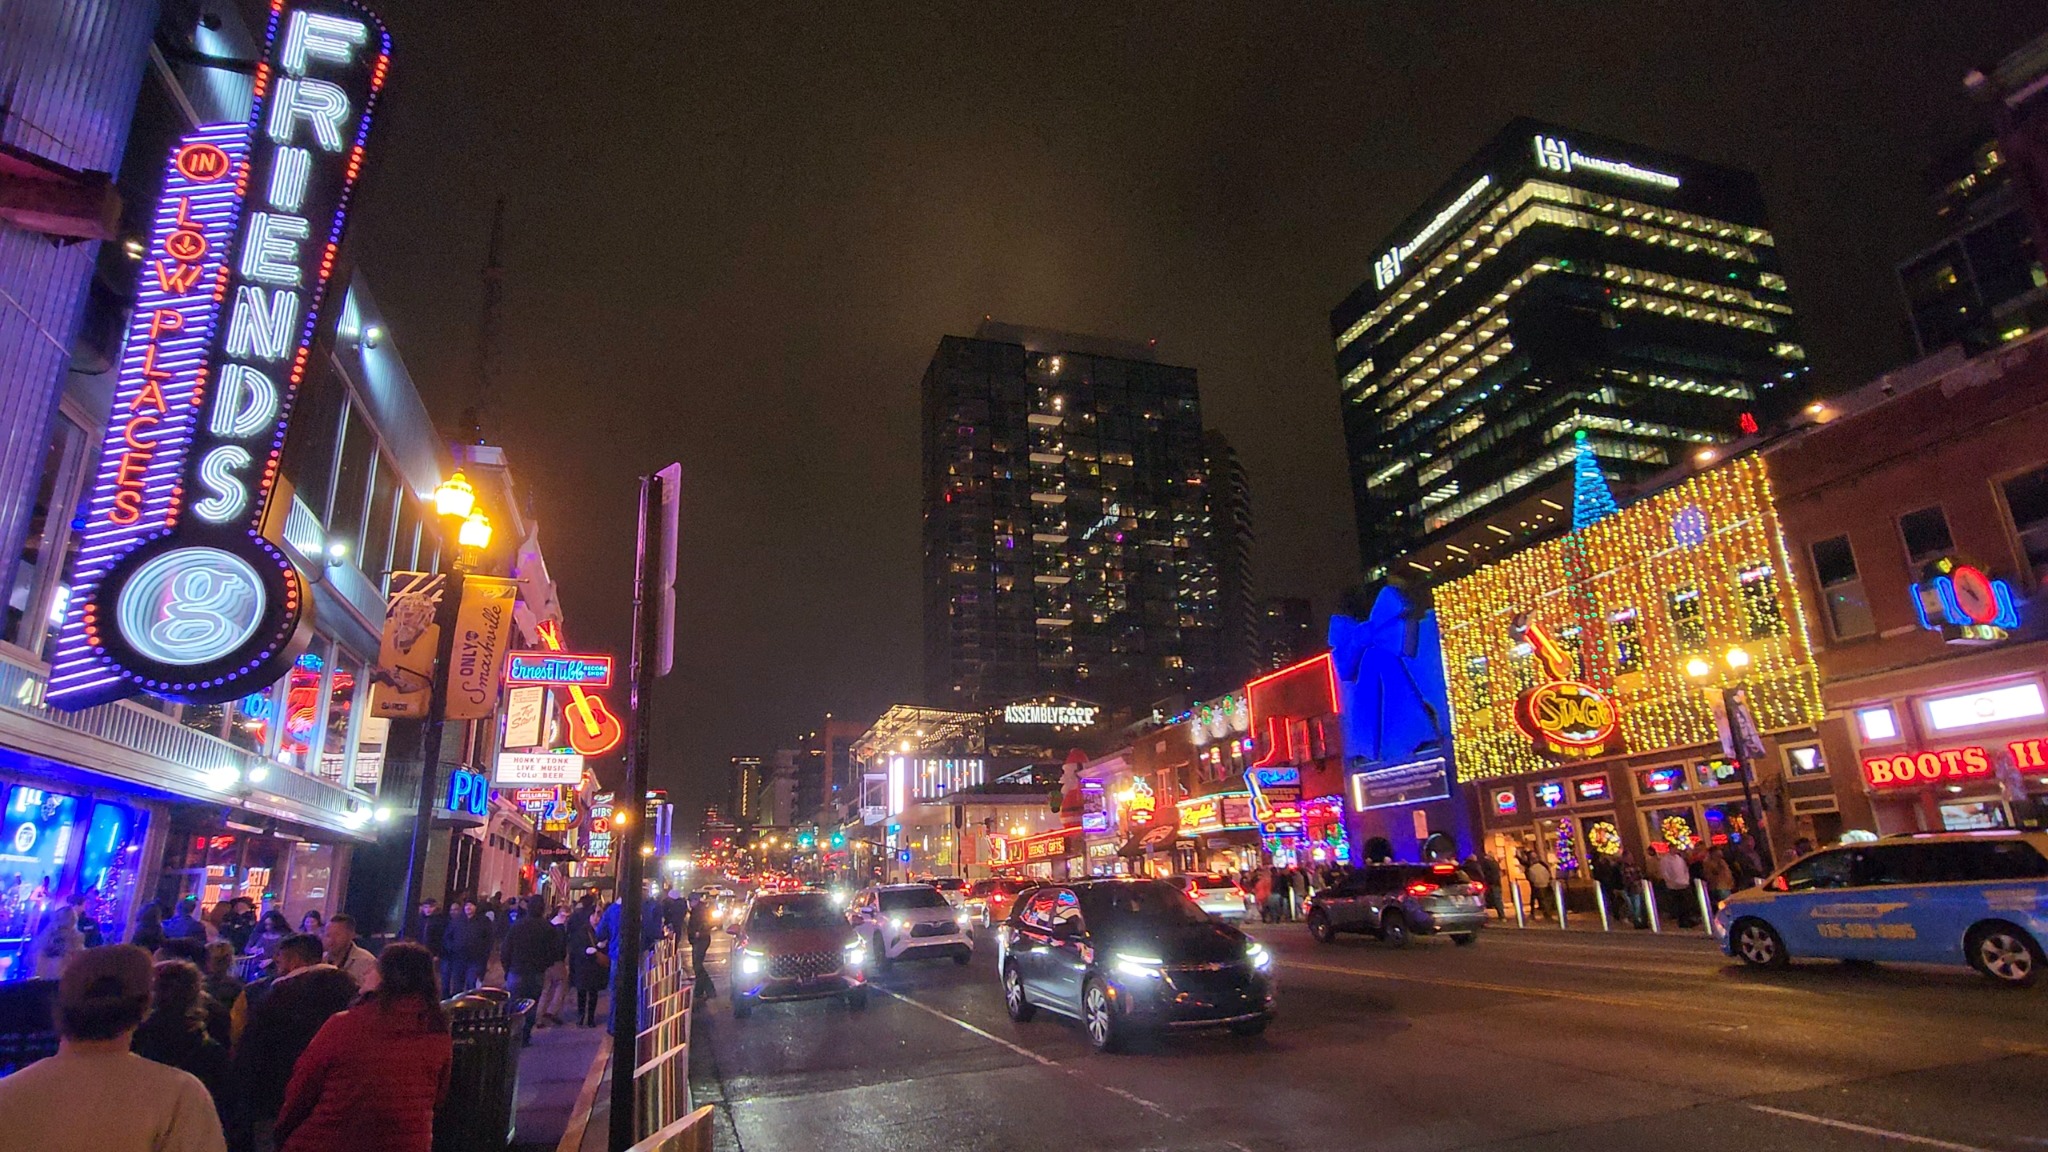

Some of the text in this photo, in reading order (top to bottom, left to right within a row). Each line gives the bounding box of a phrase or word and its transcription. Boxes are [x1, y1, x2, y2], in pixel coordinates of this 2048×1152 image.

[194, 10, 368, 523] FRIENDS
[109, 153, 216, 525] IN LOW PLACES
[460, 642, 479, 677] ONLY
[462, 604, 502, 704] Smashville
[511, 657, 584, 681] Ernest Tubb
[1004, 705, 1060, 724] ASSEMBLY
[1058, 706, 1095, 717] FOOD
[1058, 715, 1095, 725] HALL
[1537, 690, 1612, 731] STAGE
[1867, 741, 2048, 784] BOOTS H
[528, 801, 541, 809] JR
[591, 807, 613, 818] RIBS
